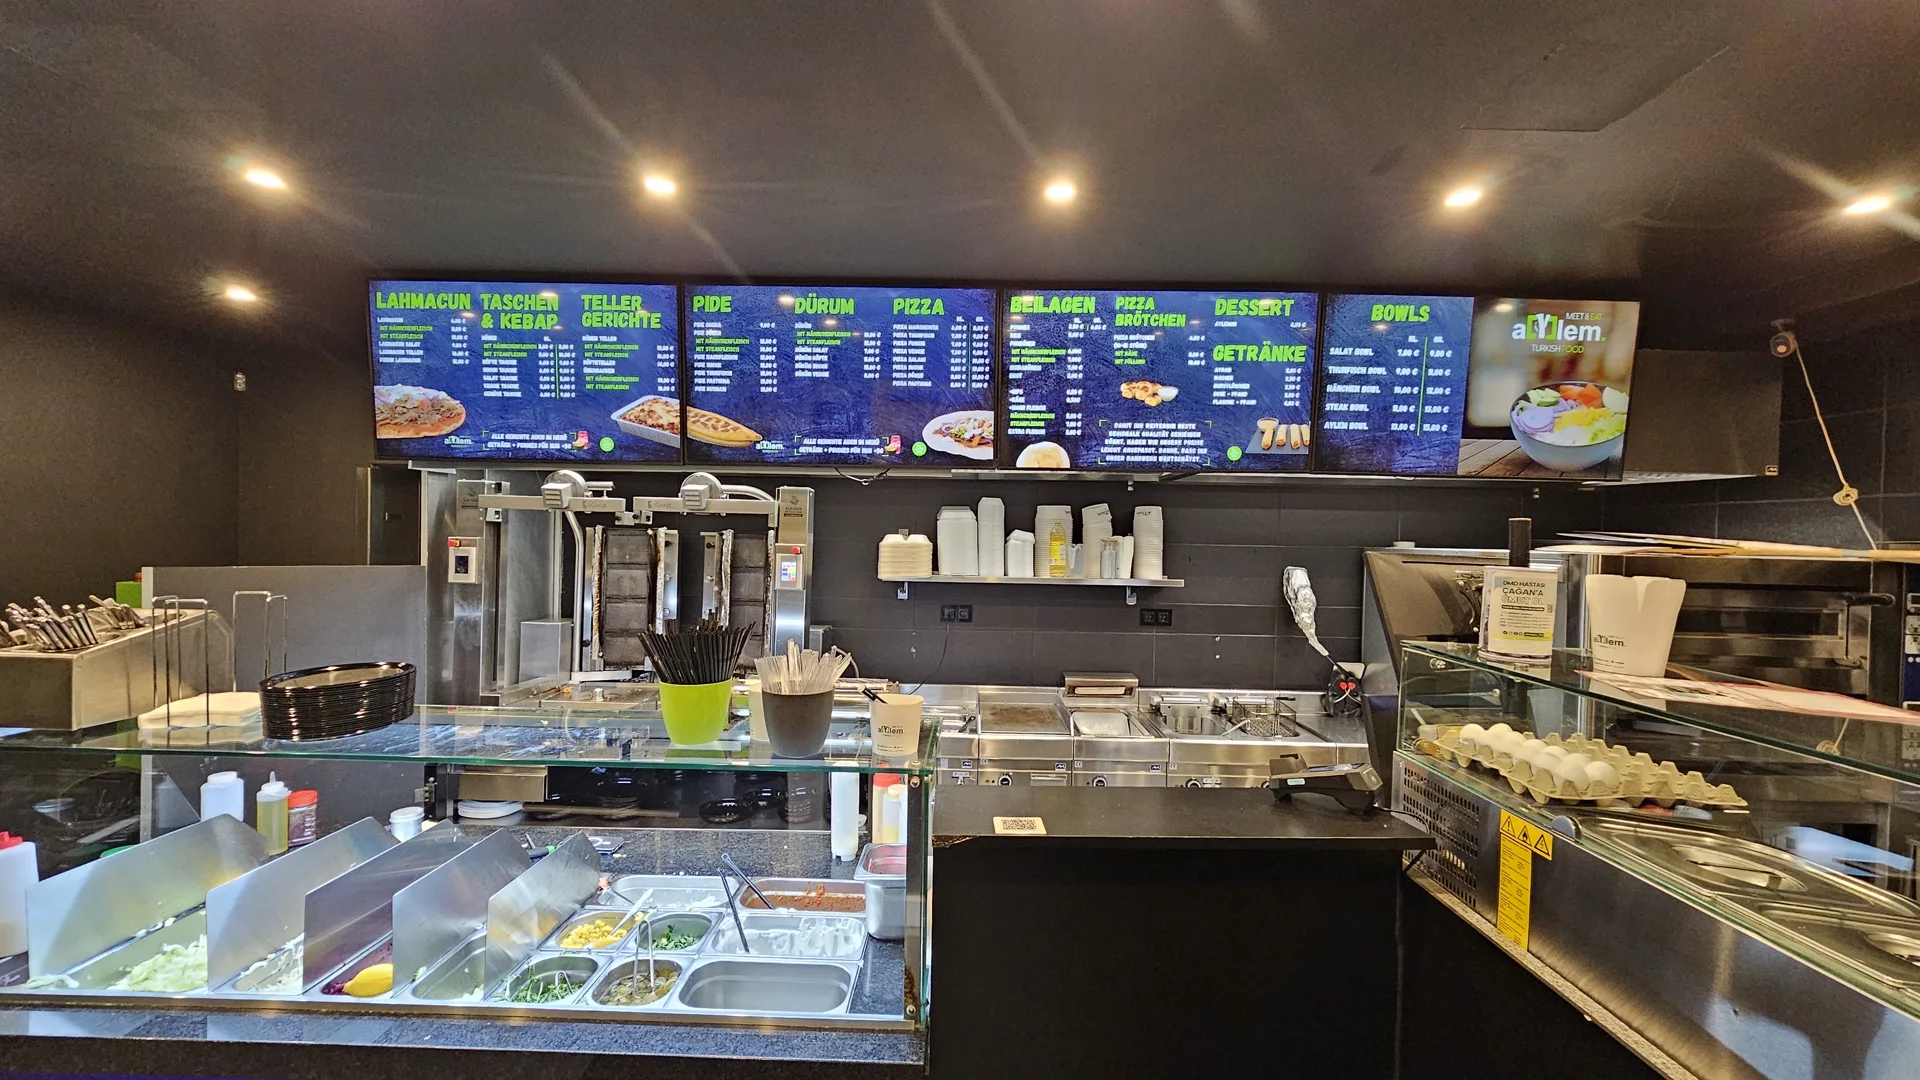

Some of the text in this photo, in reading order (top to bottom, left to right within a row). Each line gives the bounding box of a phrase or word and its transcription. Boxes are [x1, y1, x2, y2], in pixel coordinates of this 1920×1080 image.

[376, 292, 471, 309] LAHMACUN
[480, 293, 559, 310] TASCHEN
[581, 294, 643, 311] TELLER
[693, 296, 732, 312] PIDE
[794, 293, 855, 314] DÜRUM
[893, 298, 945, 315] PIZZA
[1010, 296, 1096, 314] BEILAGEN
[1116, 296, 1155, 310] PIZZA
[1215, 299, 1294, 316] DESSERT
[1371, 304, 1430, 322] BOWLS
[481, 313, 558, 329] & KEBAP
[581, 312, 662, 328] GERICHTE
[1115, 311, 1187, 327] BRÖTCHEN
[1566, 312, 1585, 320] MEET
[1589, 313, 1603, 321] EAT
[1212, 341, 1307, 362] GETRÄNKE
[1329, 347, 1374, 356] SALAT BOWL
[1413, 349, 1420, 357] €
[1445, 350, 1452, 358] €
[1531, 344, 1584, 354] TURKISH FOOD
[1328, 366, 1387, 375] THUNFISCH BOWL
[1412, 368, 1418, 376] €
[1361, 385, 1381, 394] BOWL
[1444, 387, 1451, 395] €
[1325, 403, 1370, 412] STEAK BOWL
[1442, 406, 1450, 414] €
[1324, 421, 1369, 430] AYLEM BOWL
[1409, 423, 1416, 431] €
[1441, 424, 1448, 432] €
